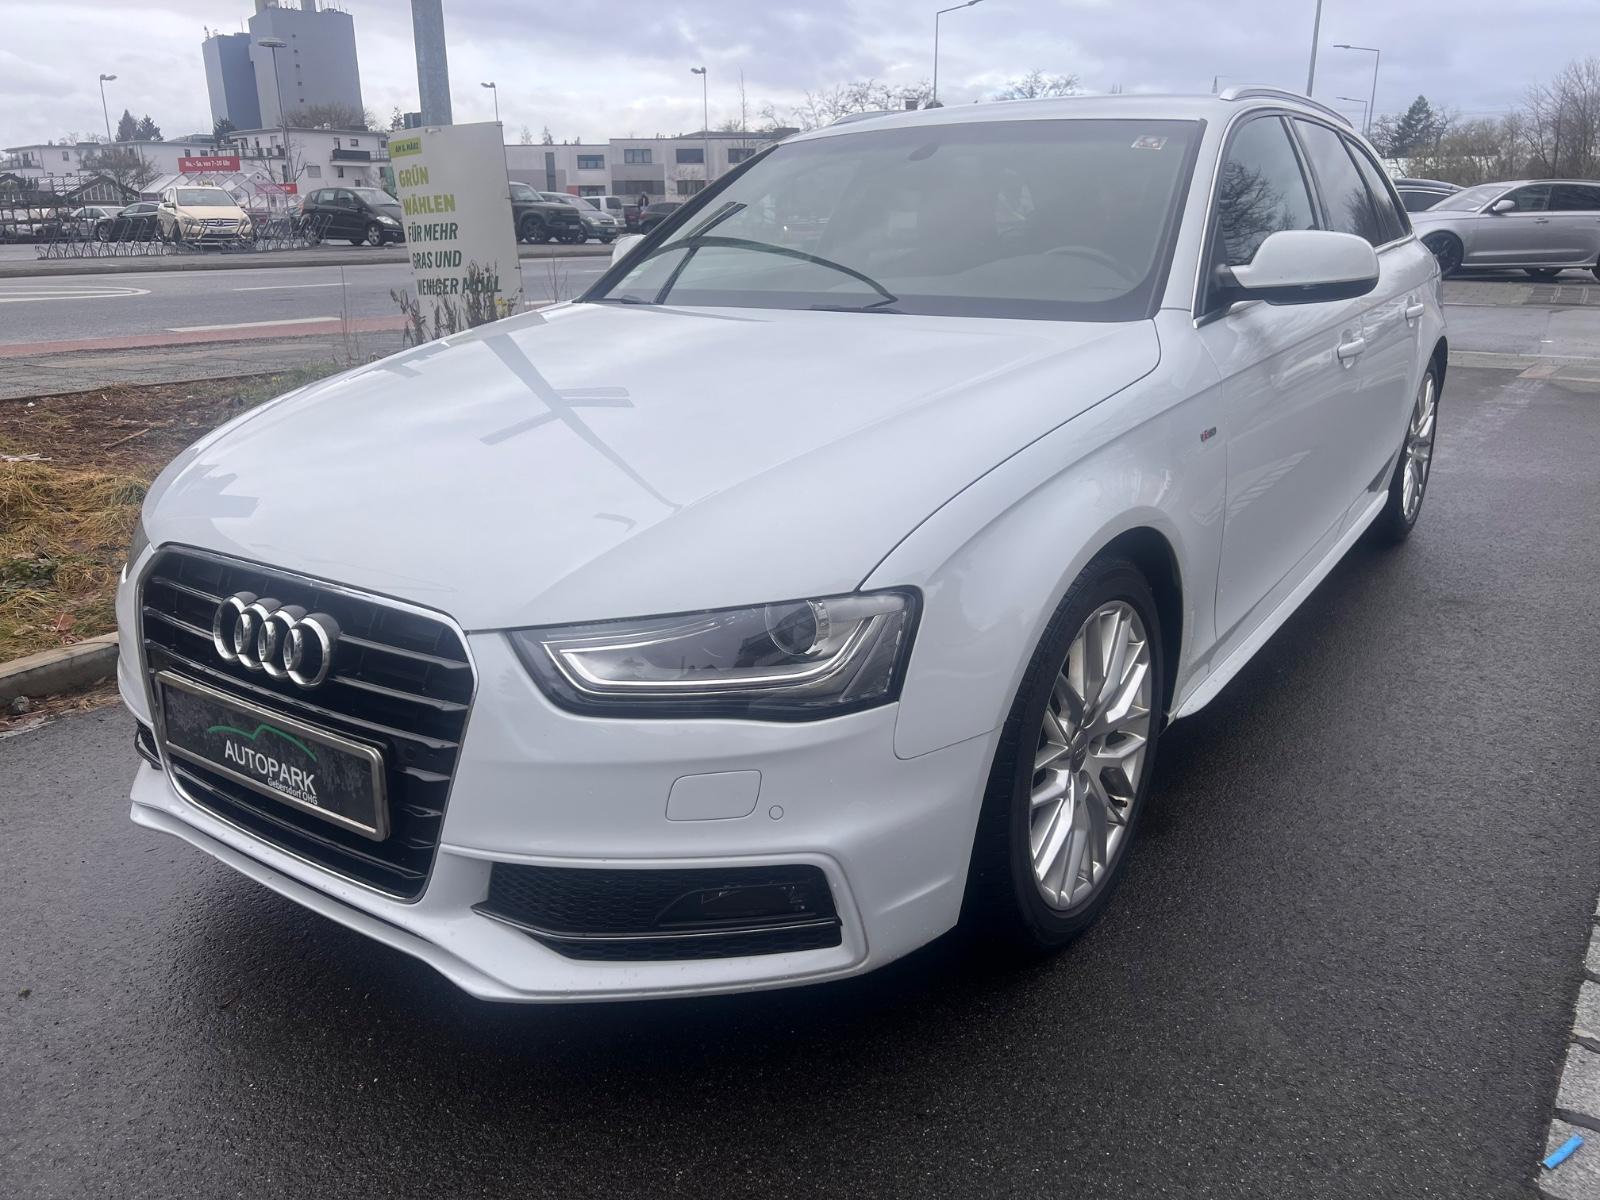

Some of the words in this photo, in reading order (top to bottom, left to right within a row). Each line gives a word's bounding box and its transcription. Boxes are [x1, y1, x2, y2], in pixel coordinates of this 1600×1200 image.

[399, 164, 429, 187] GRÜN
[402, 193, 456, 216] WÄHLEN
[407, 222, 422, 243] FÜR
[424, 222, 459, 241] MEHR
[412, 252, 432, 270] GRAS
[435, 250, 462, 268] UND
[417, 277, 459, 296] WENIGER
[224, 739, 316, 795] AUTOPARK
[302, 791, 318, 806] OHG
